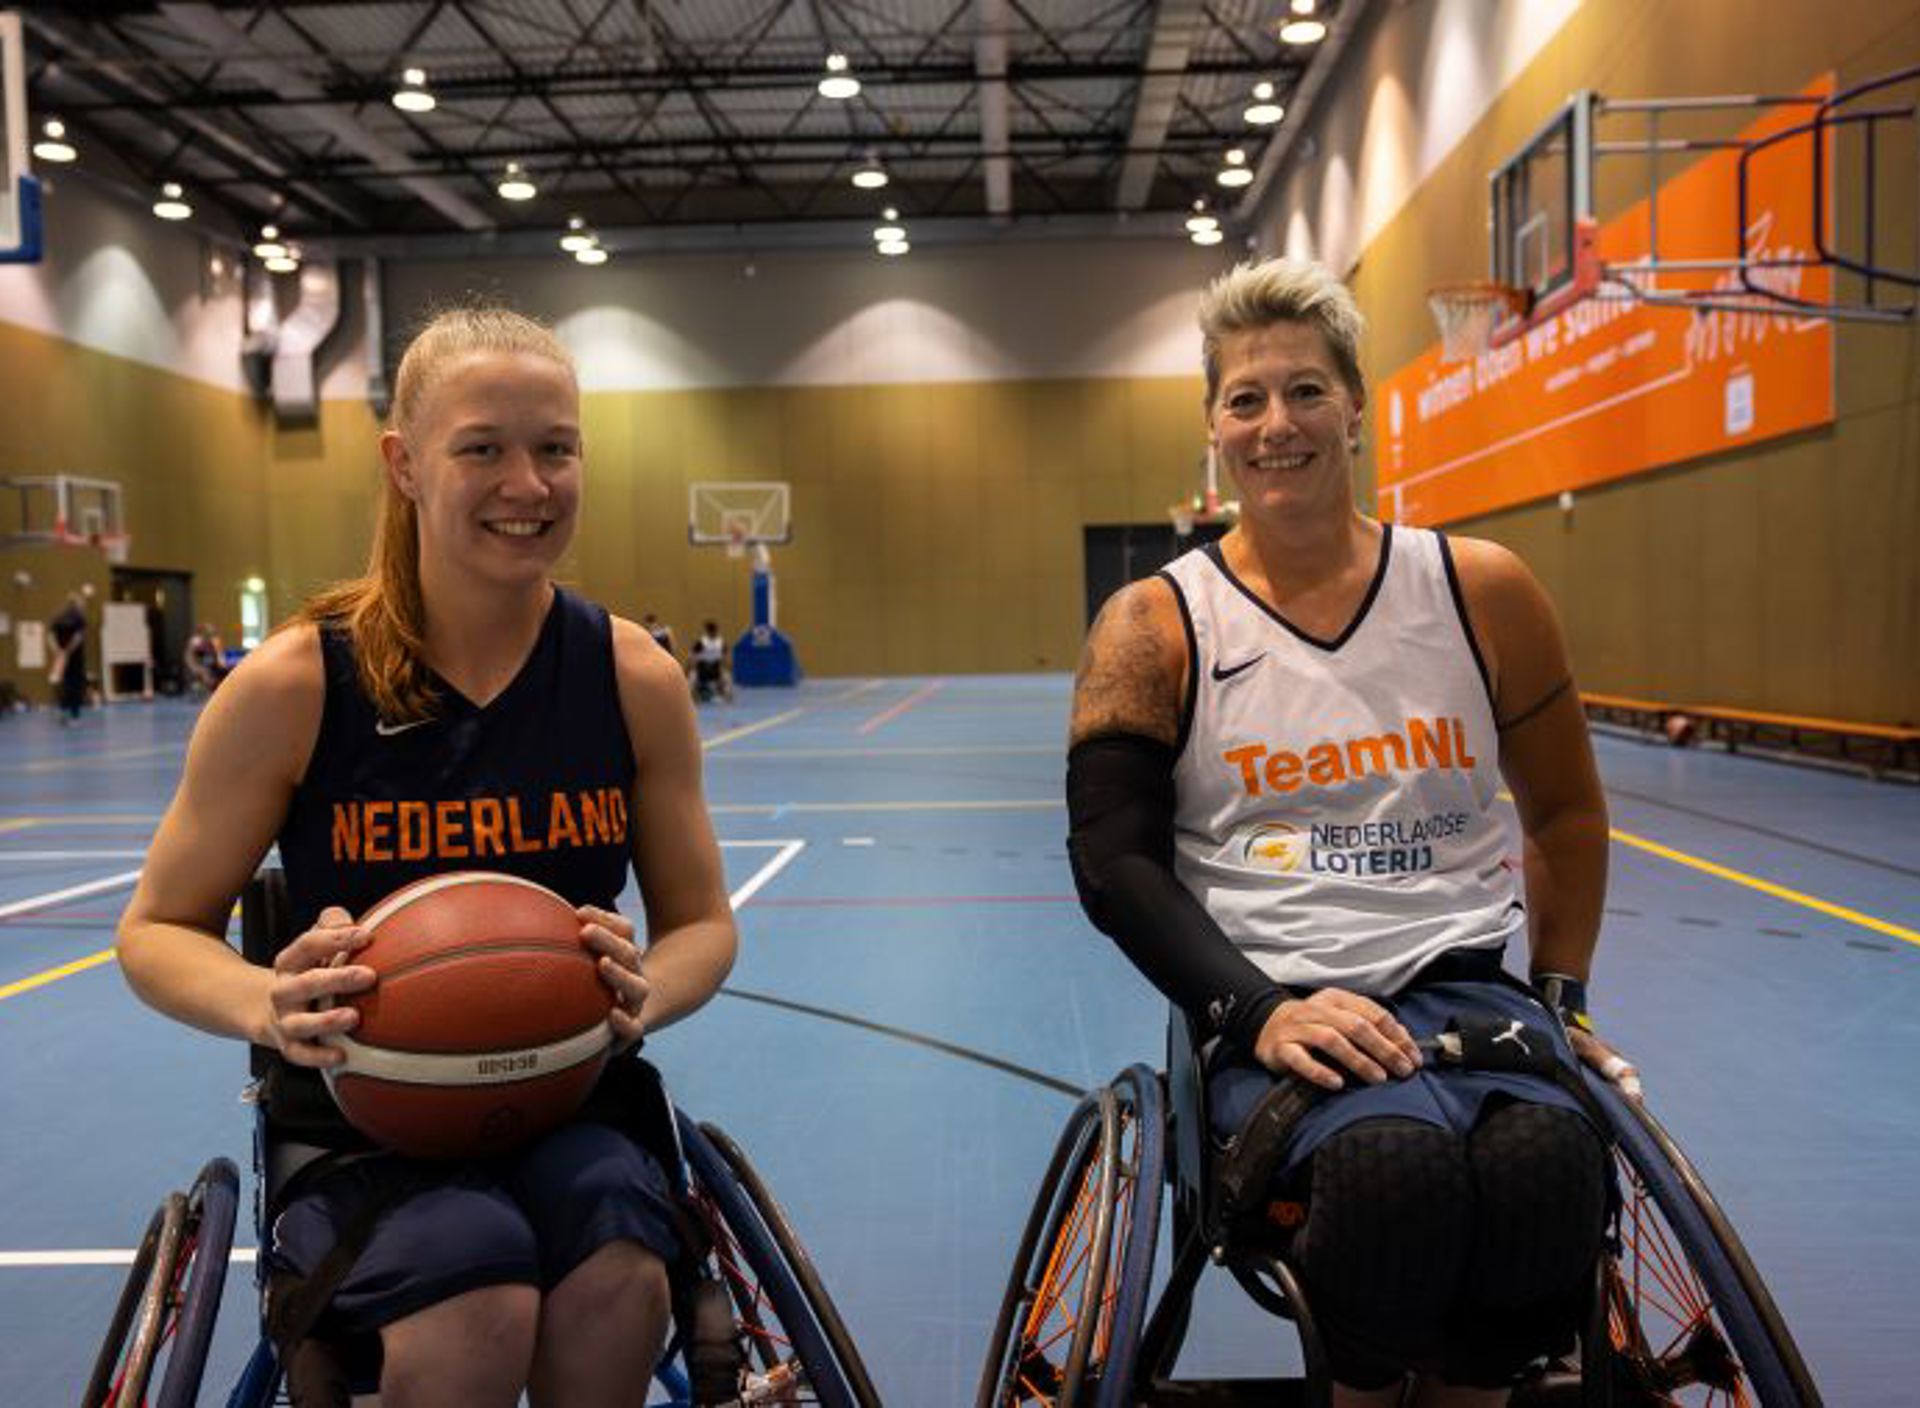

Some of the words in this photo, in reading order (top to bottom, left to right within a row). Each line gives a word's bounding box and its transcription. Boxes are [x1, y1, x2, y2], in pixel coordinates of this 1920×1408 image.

[1224, 717, 1476, 797] TeamNL
[332, 788, 627, 861] NEDERLAND
[1310, 846, 1433, 876] LOTERIJ
